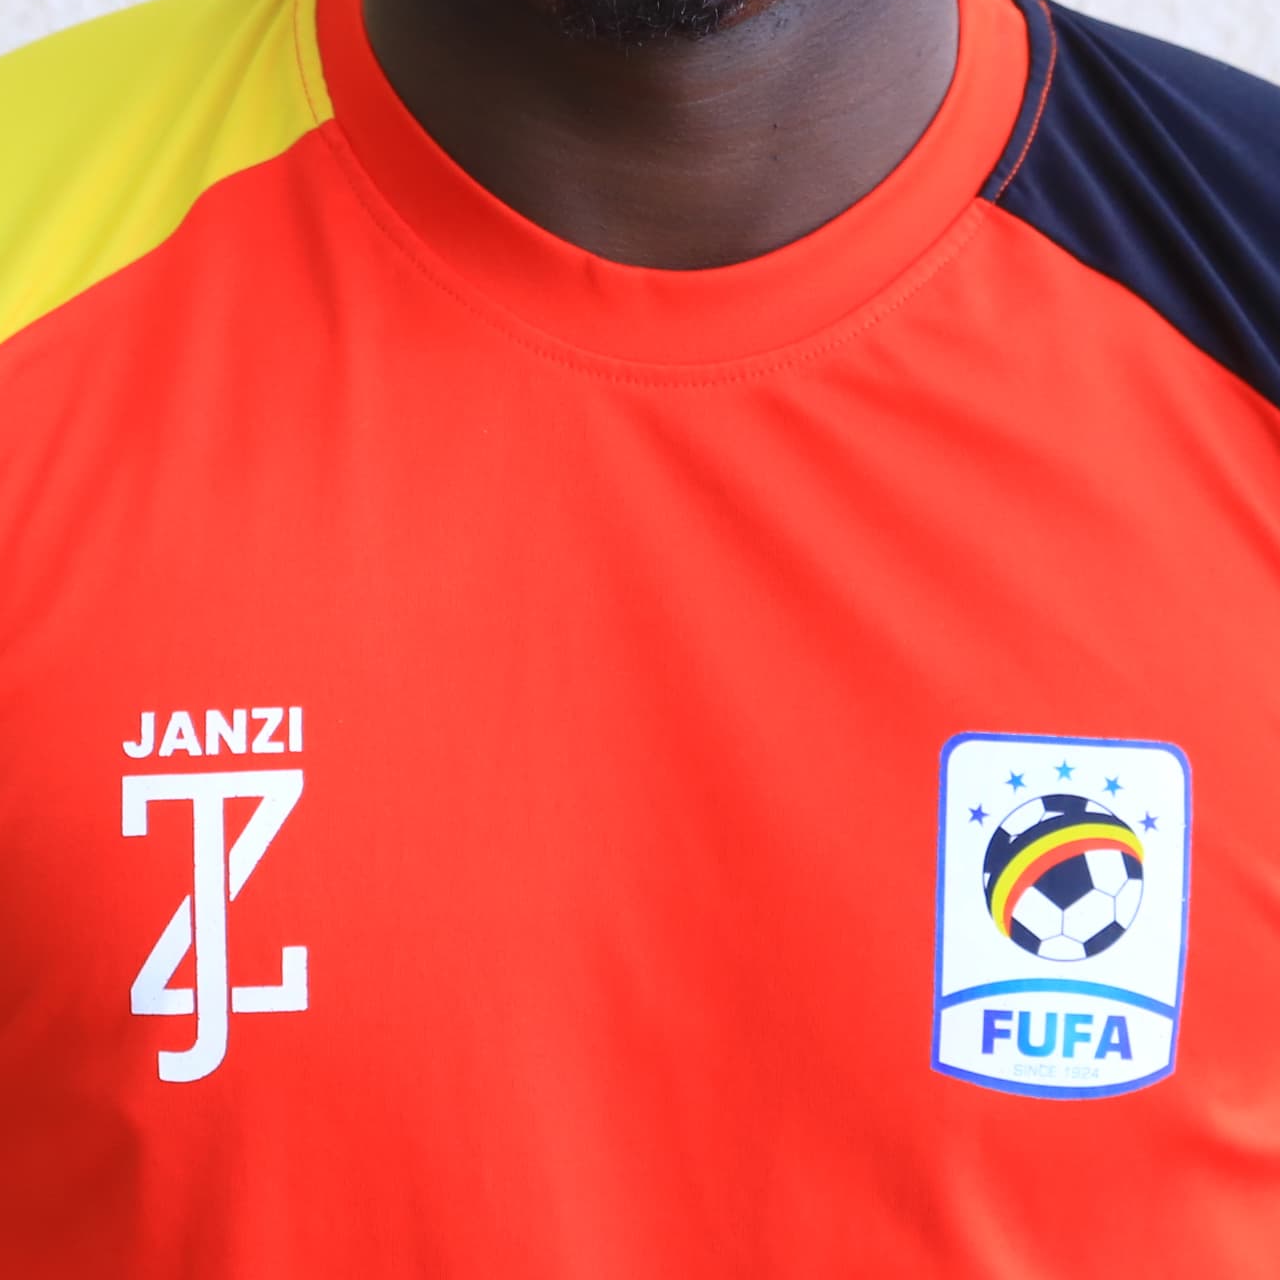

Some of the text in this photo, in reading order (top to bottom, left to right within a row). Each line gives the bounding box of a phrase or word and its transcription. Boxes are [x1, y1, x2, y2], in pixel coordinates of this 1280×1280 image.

[122, 706, 303, 757] JANZI
[981, 1009, 1132, 1060] FUFA
[1013, 1064, 1056, 1078] SINCE
